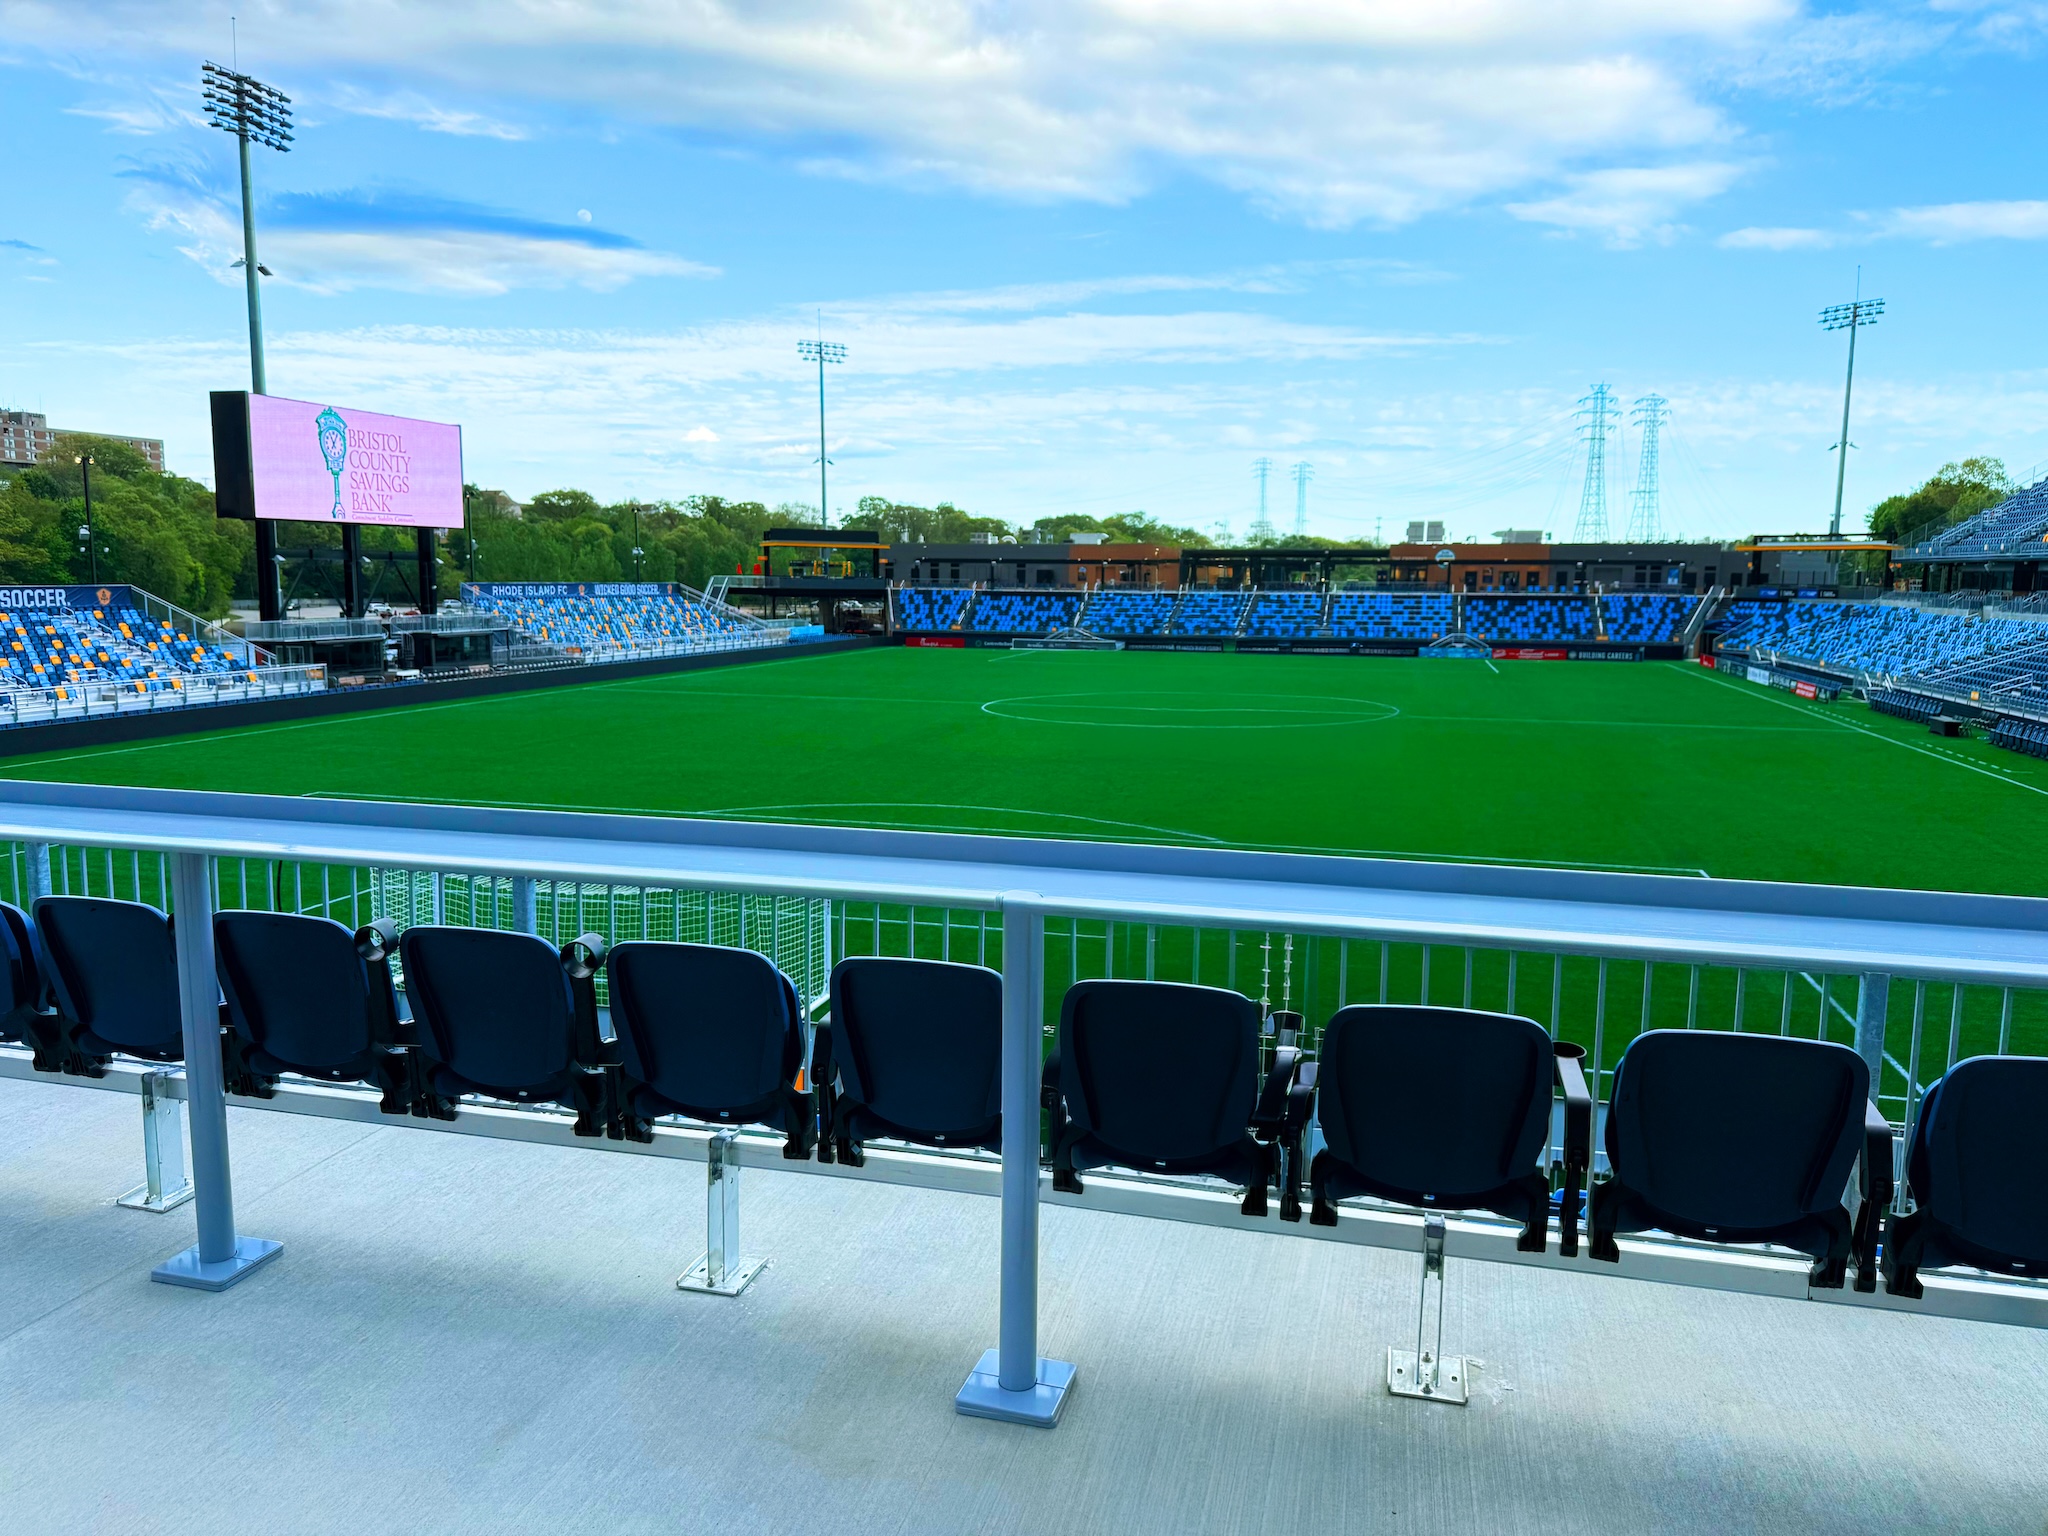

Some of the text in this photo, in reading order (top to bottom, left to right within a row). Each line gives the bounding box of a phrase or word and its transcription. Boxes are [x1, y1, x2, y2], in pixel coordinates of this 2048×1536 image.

[348, 429, 406, 453] BRISTOL
[349, 450, 411, 473] COUNTY
[350, 471, 409, 493] SAVINGS
[0, 588, 71, 608] SOCCER.
[492, 585, 568, 596] RHODE ISLAND FC
[594, 584, 620, 596] WICKED
[1578, 651, 1633, 660] BUILDING CAREERS
